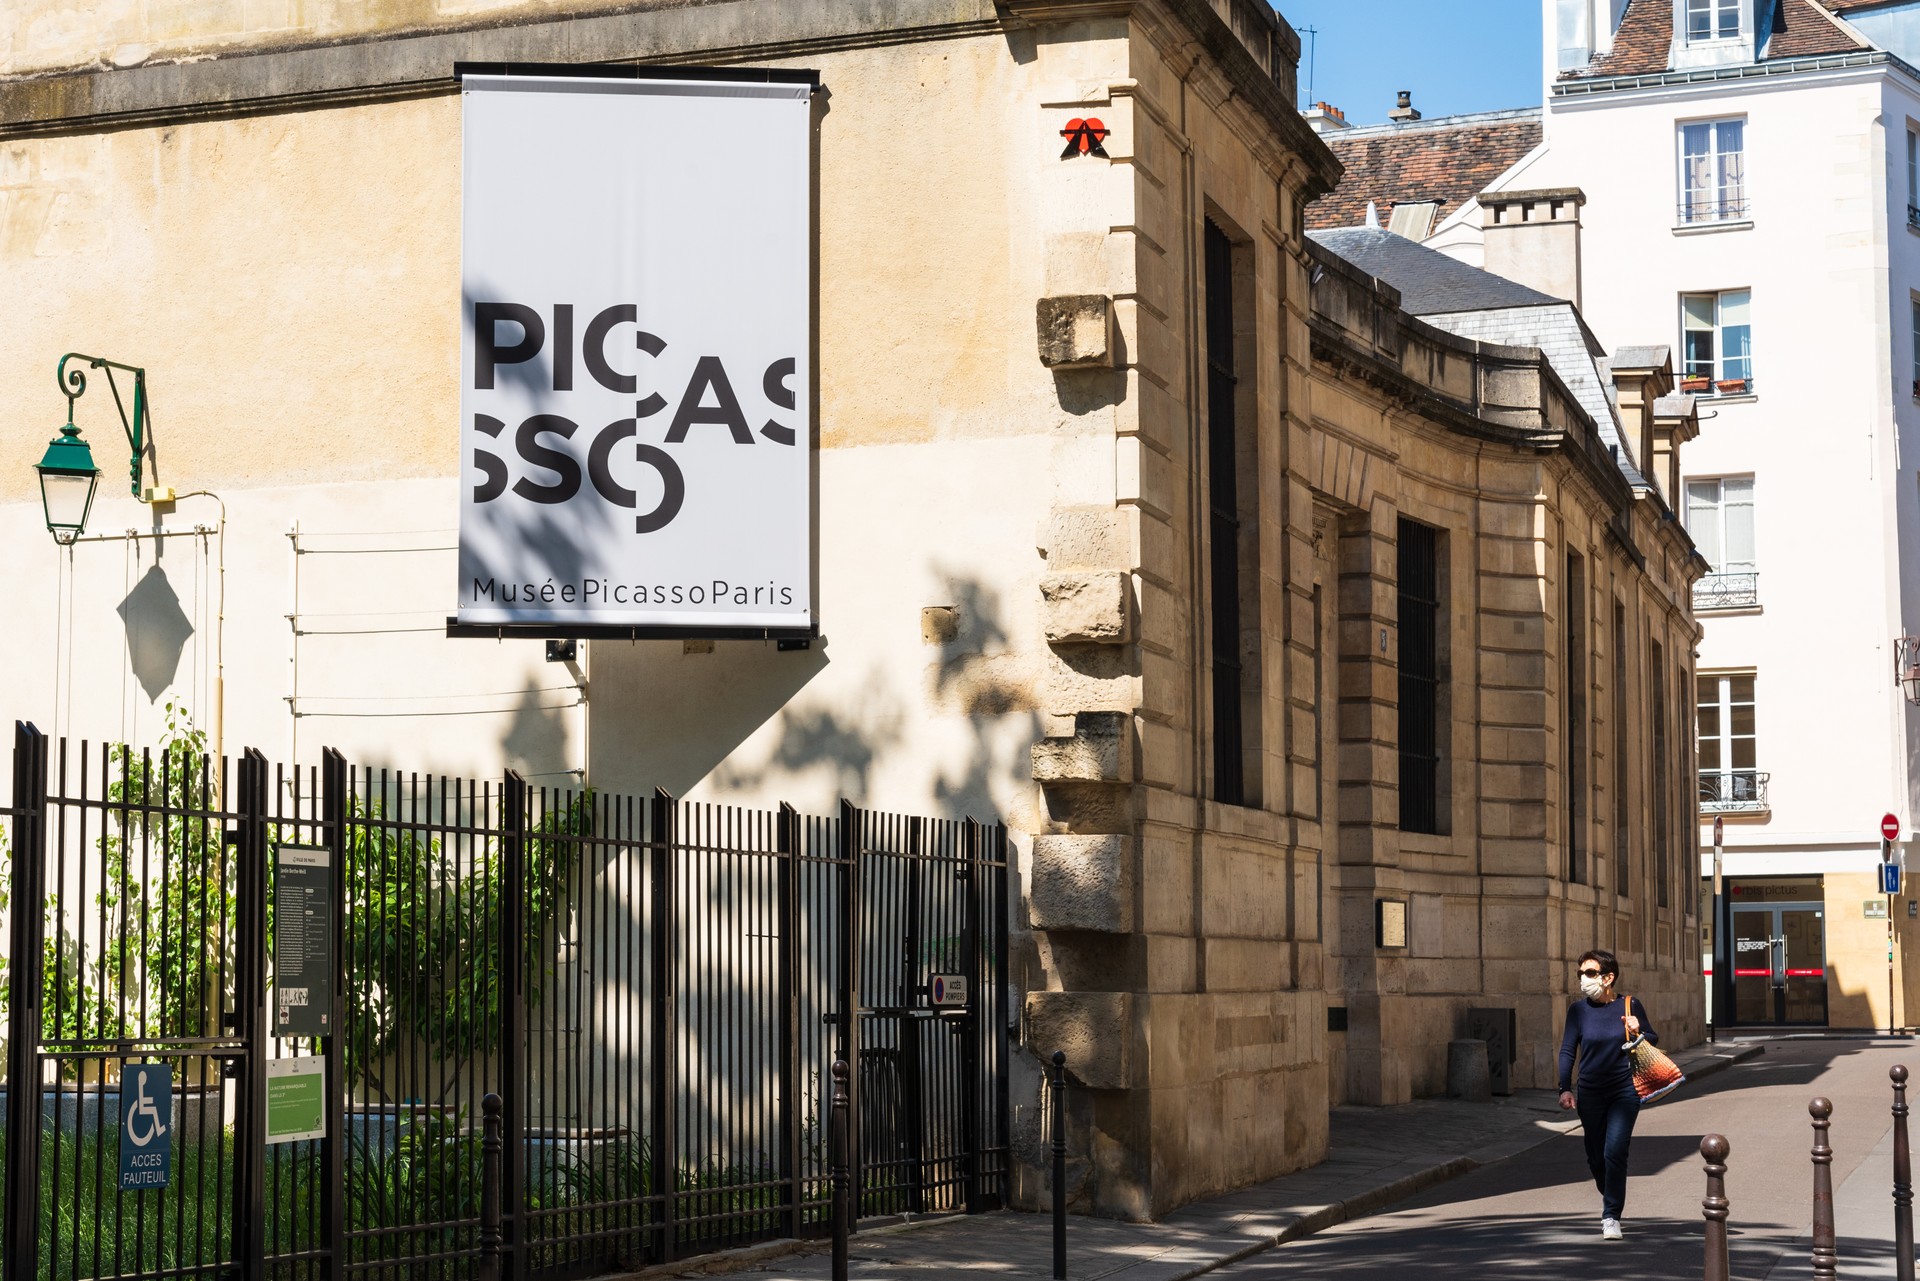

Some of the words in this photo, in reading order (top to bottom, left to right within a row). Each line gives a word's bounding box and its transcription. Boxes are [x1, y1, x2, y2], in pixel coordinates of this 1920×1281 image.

[1765, 884, 1797, 897] pictus
[949, 978, 961, 990] ACCÈS
[945, 991, 965, 1001] POMPIERS
[130, 1153, 162, 1168] ACCES
[123, 1170, 166, 1185] FAUTEUIL
